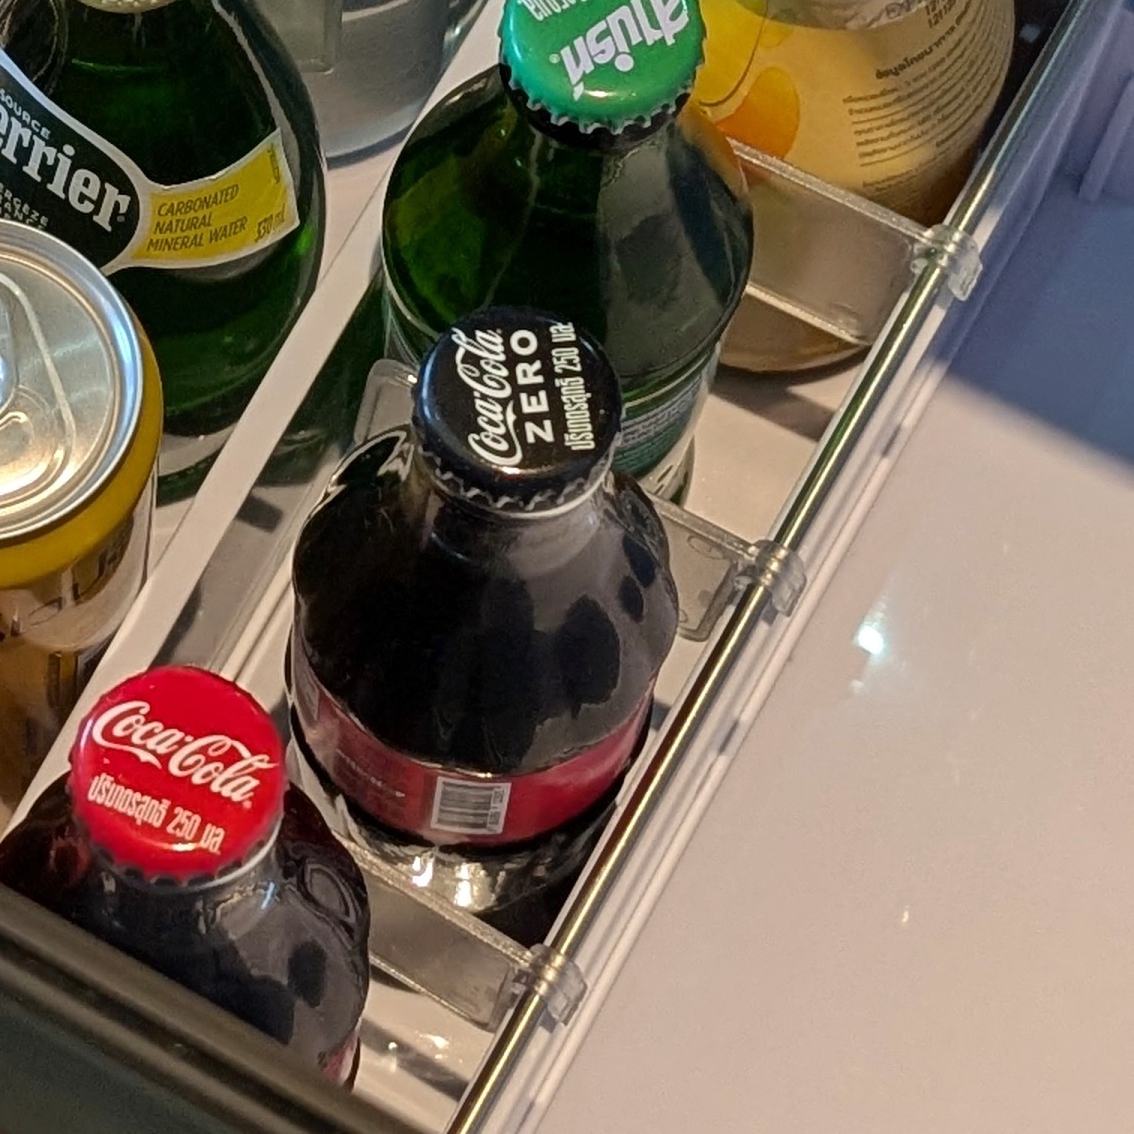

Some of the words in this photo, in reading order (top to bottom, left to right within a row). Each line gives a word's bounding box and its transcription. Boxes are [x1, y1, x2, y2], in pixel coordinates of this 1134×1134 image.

[0, 88, 51, 140] SOURCE
[157, 183, 240, 217] CARBONATED
[146, 234, 205, 252] MINERAL
[208, 216, 249, 244] WATER
[154, 211, 213, 235] NATURAL
[551, 347, 582, 374] 250
[451, 327, 523, 466] Coca-Cola
[510, 329, 555, 444] ZERO
[92, 700, 278, 804] Coca-Cola
[166, 807, 202, 841] 250
